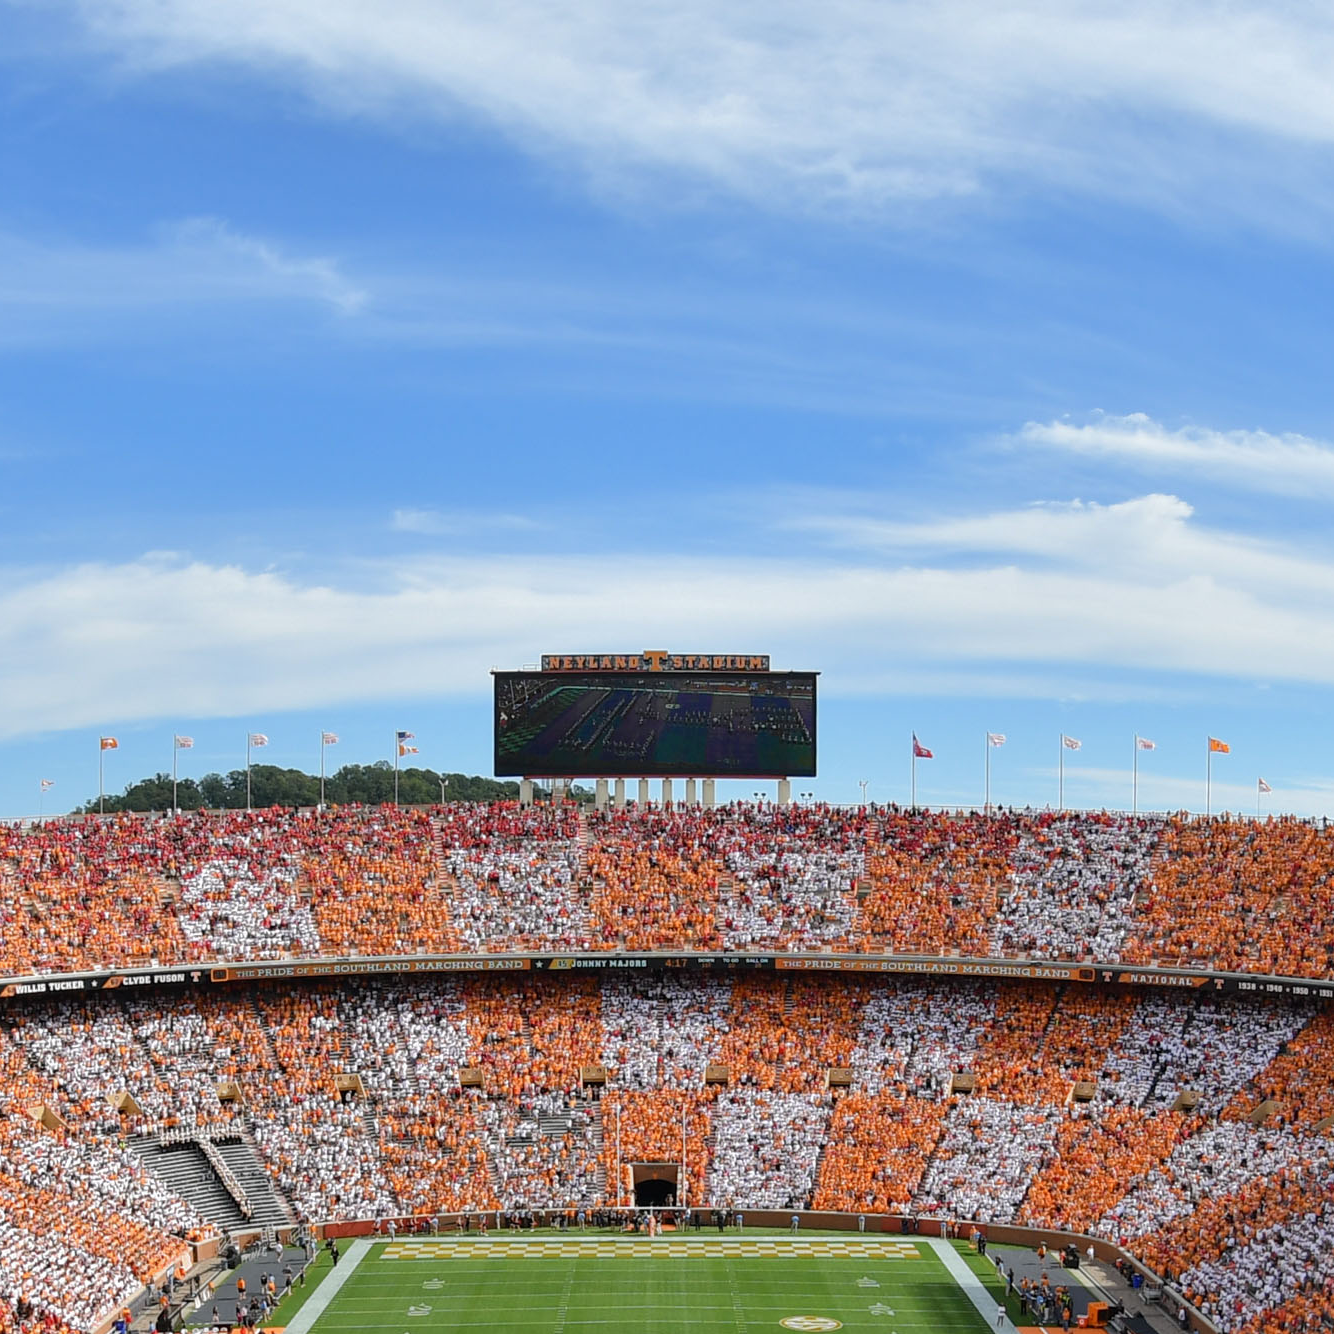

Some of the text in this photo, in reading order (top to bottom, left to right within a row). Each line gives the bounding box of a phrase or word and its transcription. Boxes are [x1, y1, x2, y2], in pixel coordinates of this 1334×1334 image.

[548, 655, 639, 670] NEYLAND
[672, 655, 764, 670] STADIUM
[257, 968, 294, 977] PRIDE
[313, 966, 331, 974] THE
[334, 963, 411, 972] SOUTHLAND
[415, 961, 483, 970] MARCHING
[488, 960, 524, 968] BAND
[571, 960, 647, 968] JOHNNY MAJORS
[804, 960, 841, 968] PRIDE
[881, 963, 958, 973] SOUTHLAND
[963, 965, 1030, 977] MARCHING
[1035, 969, 1070, 978] BAND
[123, 975, 151, 985] CLYDE
[154, 973, 185, 983] FUSON
[1130, 974, 1192, 986] NATIONAL
[16, 984, 46, 994] WILLIS
[48, 980, 84, 991] TUCKER
